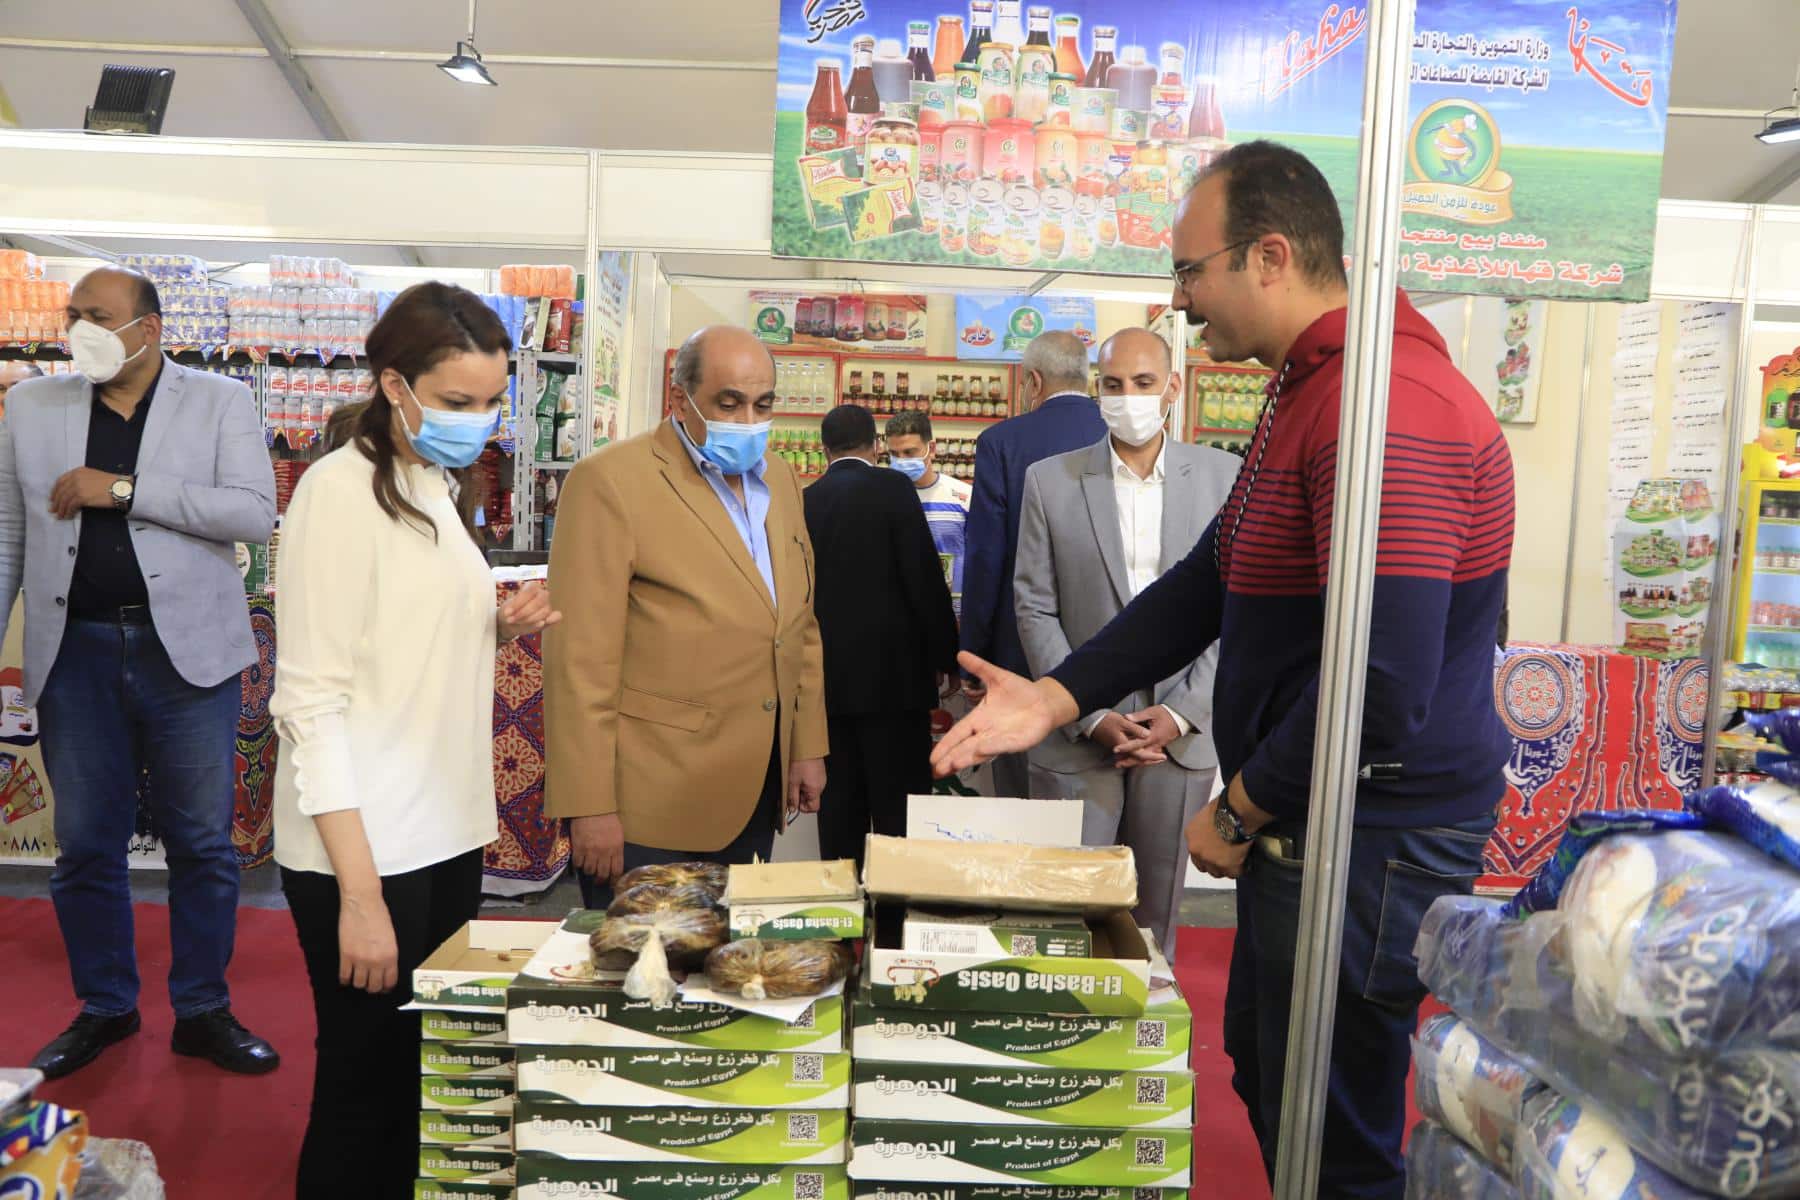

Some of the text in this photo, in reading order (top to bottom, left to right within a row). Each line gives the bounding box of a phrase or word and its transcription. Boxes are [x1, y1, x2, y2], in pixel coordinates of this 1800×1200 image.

[1432, 33, 1477, 55] والتجارة
[1480, 38, 1522, 58] التموين
[1526, 38, 1550, 59] وزارة
[1421, 65, 1467, 83] للصناعات
[1470, 65, 1510, 90] القابضة
[1512, 68, 1548, 91] الشركة
[1461, 234, 1494, 249] بيع
[1416, 253, 1510, 280] للأغذية
[1559, 262, 1622, 286] شركة
[773, 917, 804, 930] Oasis
[958, 970, 1122, 996] El-Basha Oasis
[527, 1000, 607, 1021] الجوهرة
[621, 1000, 651, 1011] مصر
[656, 1015, 730, 1033] Product of Egypt
[874, 1018, 956, 1039] الجوهرة
[971, 1017, 1123, 1032] بكل فخر زرع وصنع فى مصر
[1005, 1033, 1080, 1052] Product of Egypt
[536, 1054, 616, 1076] الجوهرة
[629, 1052, 781, 1068] بكل فخر زرع وصنع فى مصر
[664, 1068, 739, 1088] Product of Egypt
[875, 1075, 957, 1096] الجوهرة
[971, 1073, 1123, 1089] بكل فخر زرع وصنع فى مصر
[1006, 1090, 1080, 1109] Product of Egypt
[531, 1115, 612, 1135] الجوهرة
[626, 1111, 776, 1126] بكل فخر زرع وصنع فى مصر
[660, 1127, 734, 1146] Product of Egypt
[971, 1134, 1122, 1151] بكل فخر زرع وصنع فى مصر
[874, 1137, 956, 1159] الجوهرة
[1005, 1151, 1080, 1170] Product of Egypt
[538, 1177, 618, 1196] الجوهرة
[633, 1172, 782, 1187] بكل فخر زرع وصنع فى مصر
